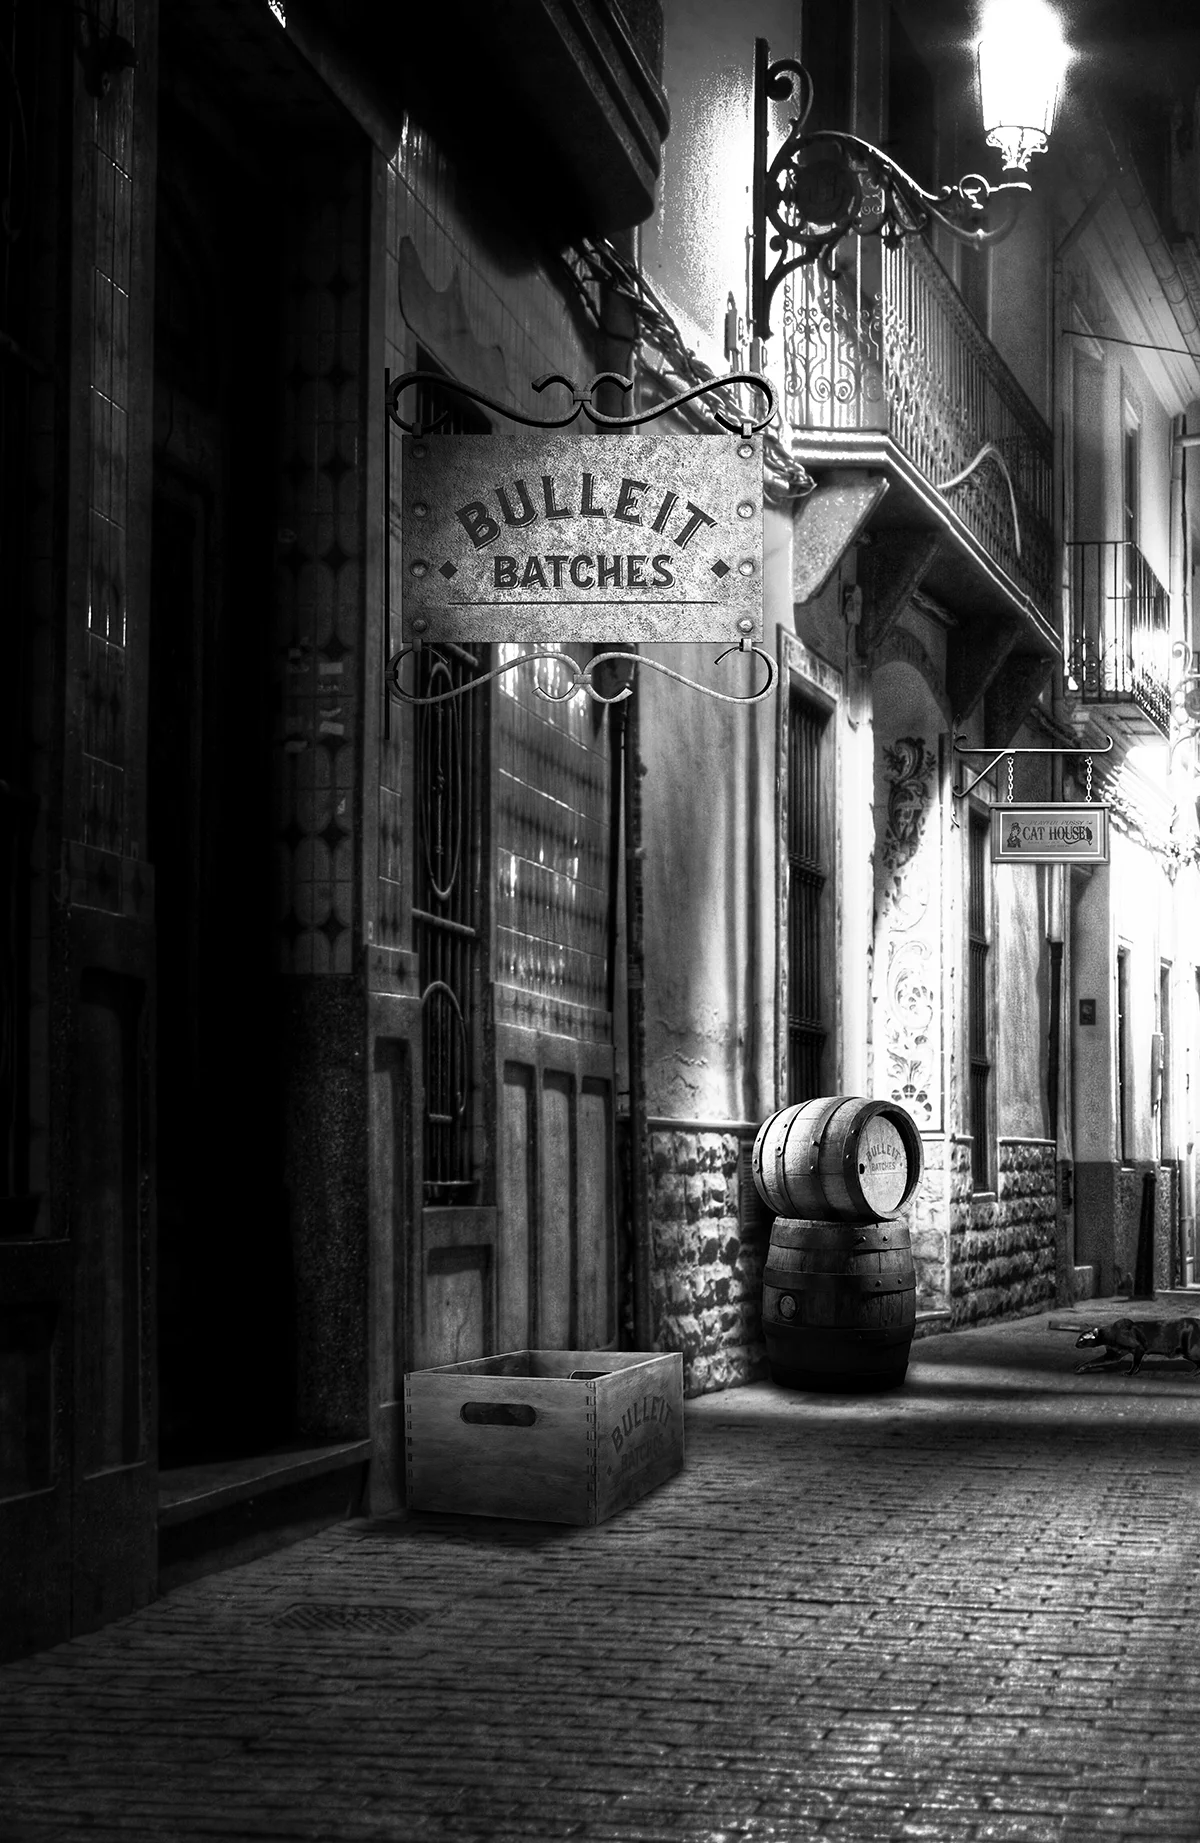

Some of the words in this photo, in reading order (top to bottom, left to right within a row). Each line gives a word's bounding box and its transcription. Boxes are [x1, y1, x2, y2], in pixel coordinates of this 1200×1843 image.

[455, 472, 718, 550] BULLEIT
[493, 554, 676, 590] BATCHES
[1022, 826, 1045, 841] CAT
[1049, 826, 1086, 841] HOUSE
[865, 1143, 901, 1162] BULLEIT
[871, 1161, 896, 1171] BATCHES
[611, 1396, 673, 1455] BULLEIT
